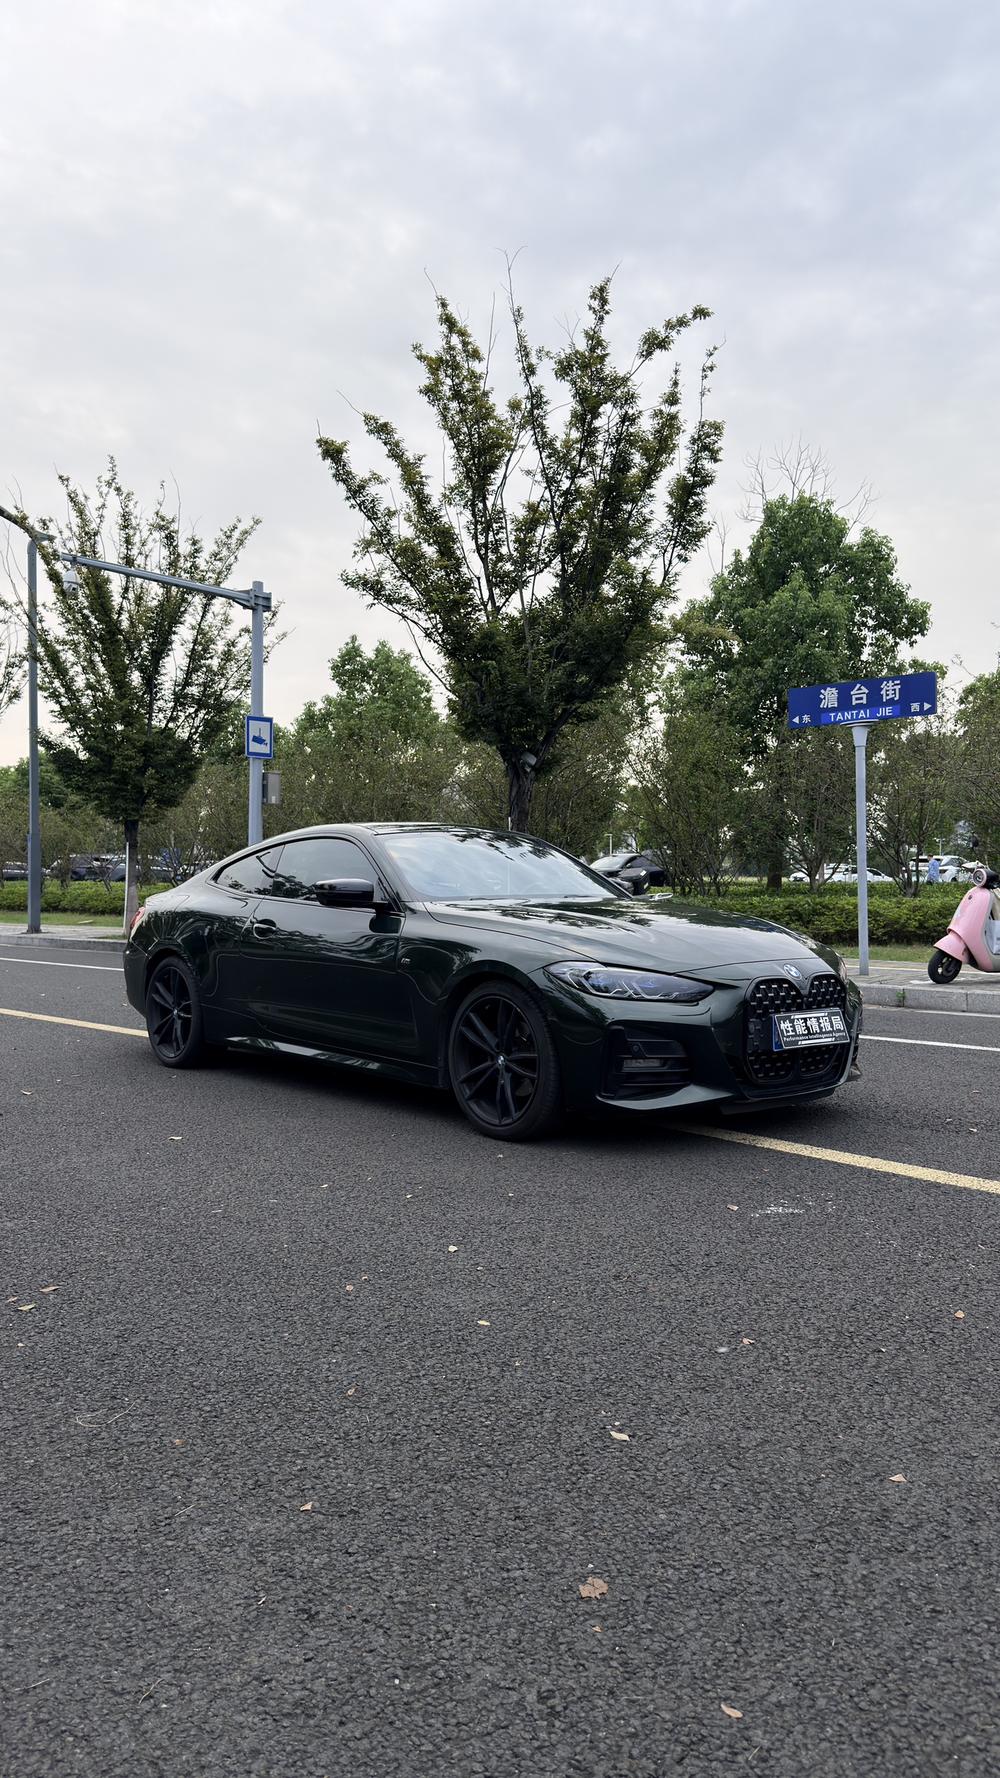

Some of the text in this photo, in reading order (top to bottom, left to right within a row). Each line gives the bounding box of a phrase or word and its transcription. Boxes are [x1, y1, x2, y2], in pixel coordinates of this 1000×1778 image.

[819, 680, 901, 709] 澹台街
[829, 707, 893, 722] TANTAI JIE
[910, 702, 920, 712] 西
[802, 714, 811, 723] 东
[780, 1016, 844, 1036] 性能情报局
